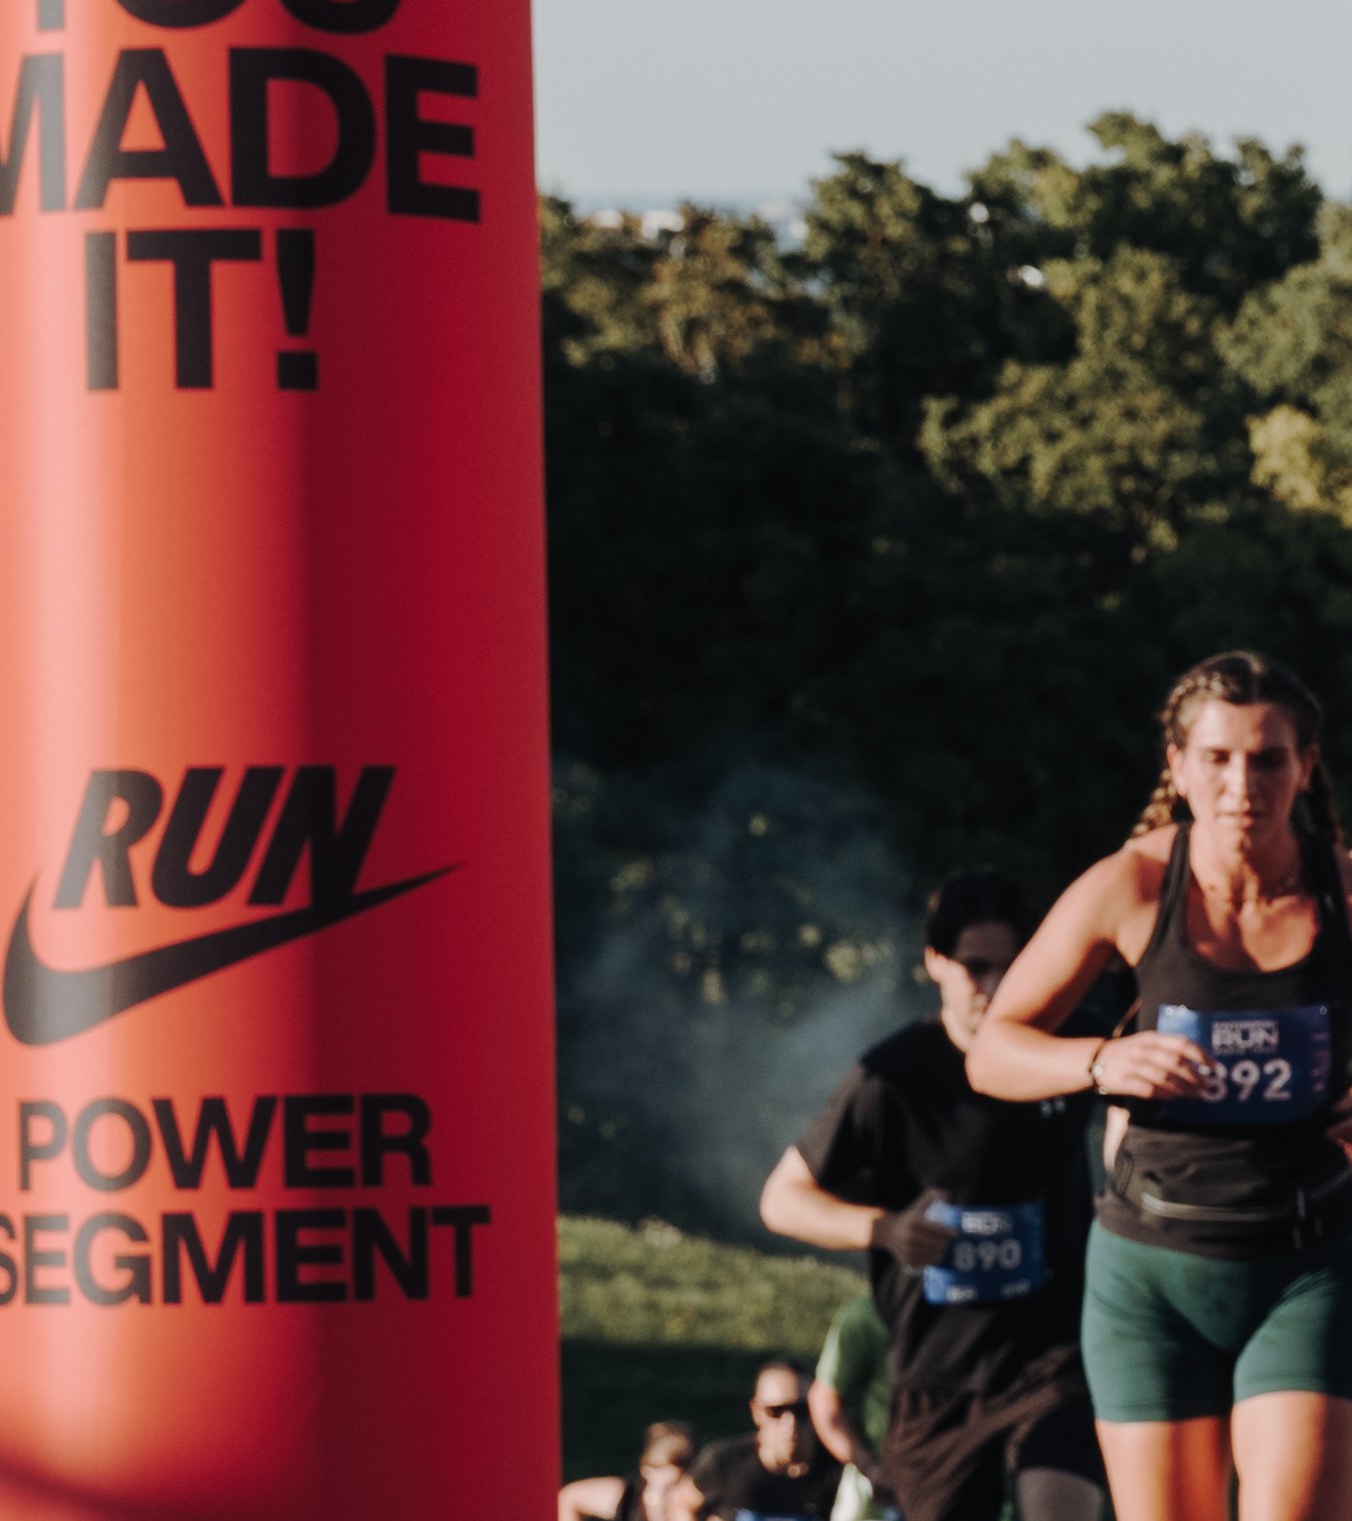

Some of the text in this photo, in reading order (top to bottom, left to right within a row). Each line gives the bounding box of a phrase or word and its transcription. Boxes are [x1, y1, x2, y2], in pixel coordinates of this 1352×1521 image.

[85, 227, 318, 392] IT!
[52, 765, 396, 911] RUN
[18, 1093, 434, 1192] POWER
